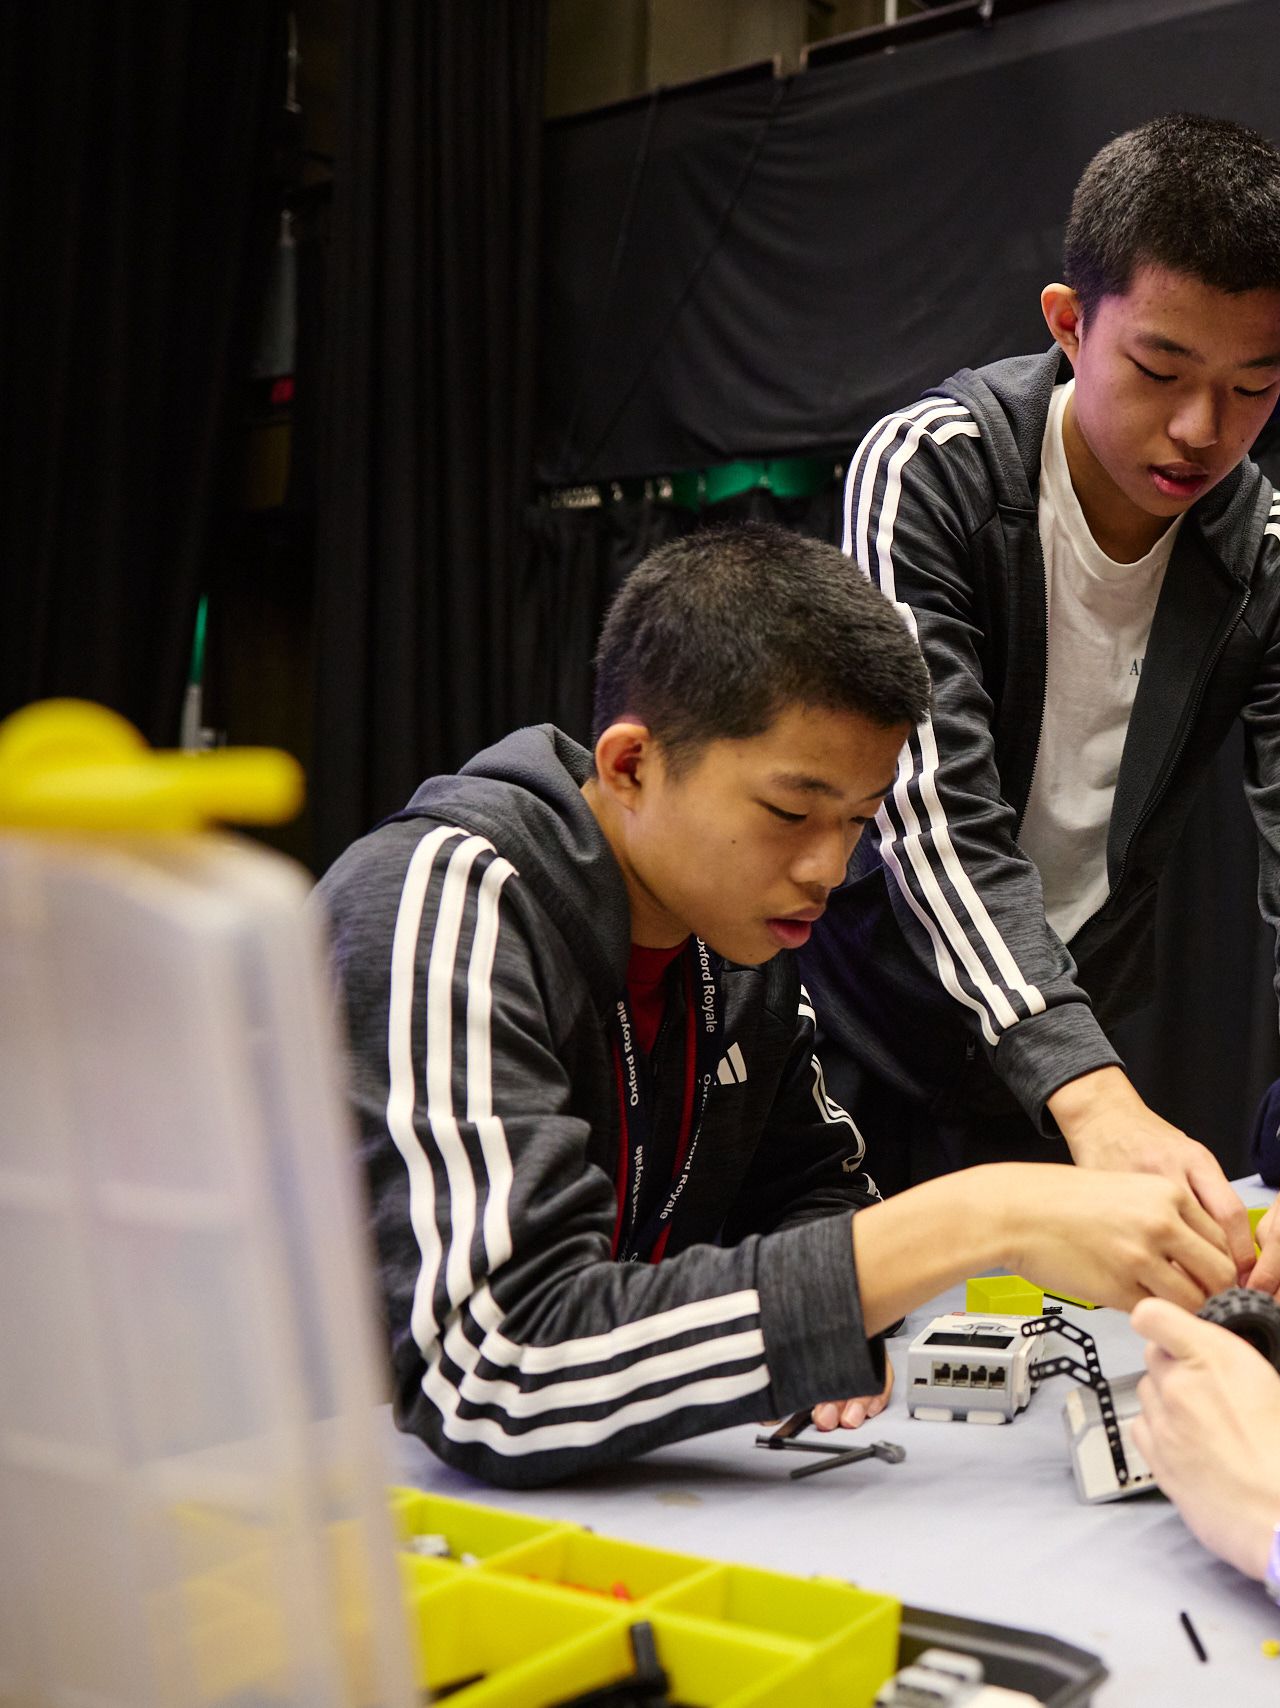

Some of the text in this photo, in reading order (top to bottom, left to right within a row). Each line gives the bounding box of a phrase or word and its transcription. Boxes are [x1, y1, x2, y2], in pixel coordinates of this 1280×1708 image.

[702, 984, 718, 1033] Royale
[616, 1000, 639, 1107] Oxford Royale
[660, 1174, 688, 1220] Royale
